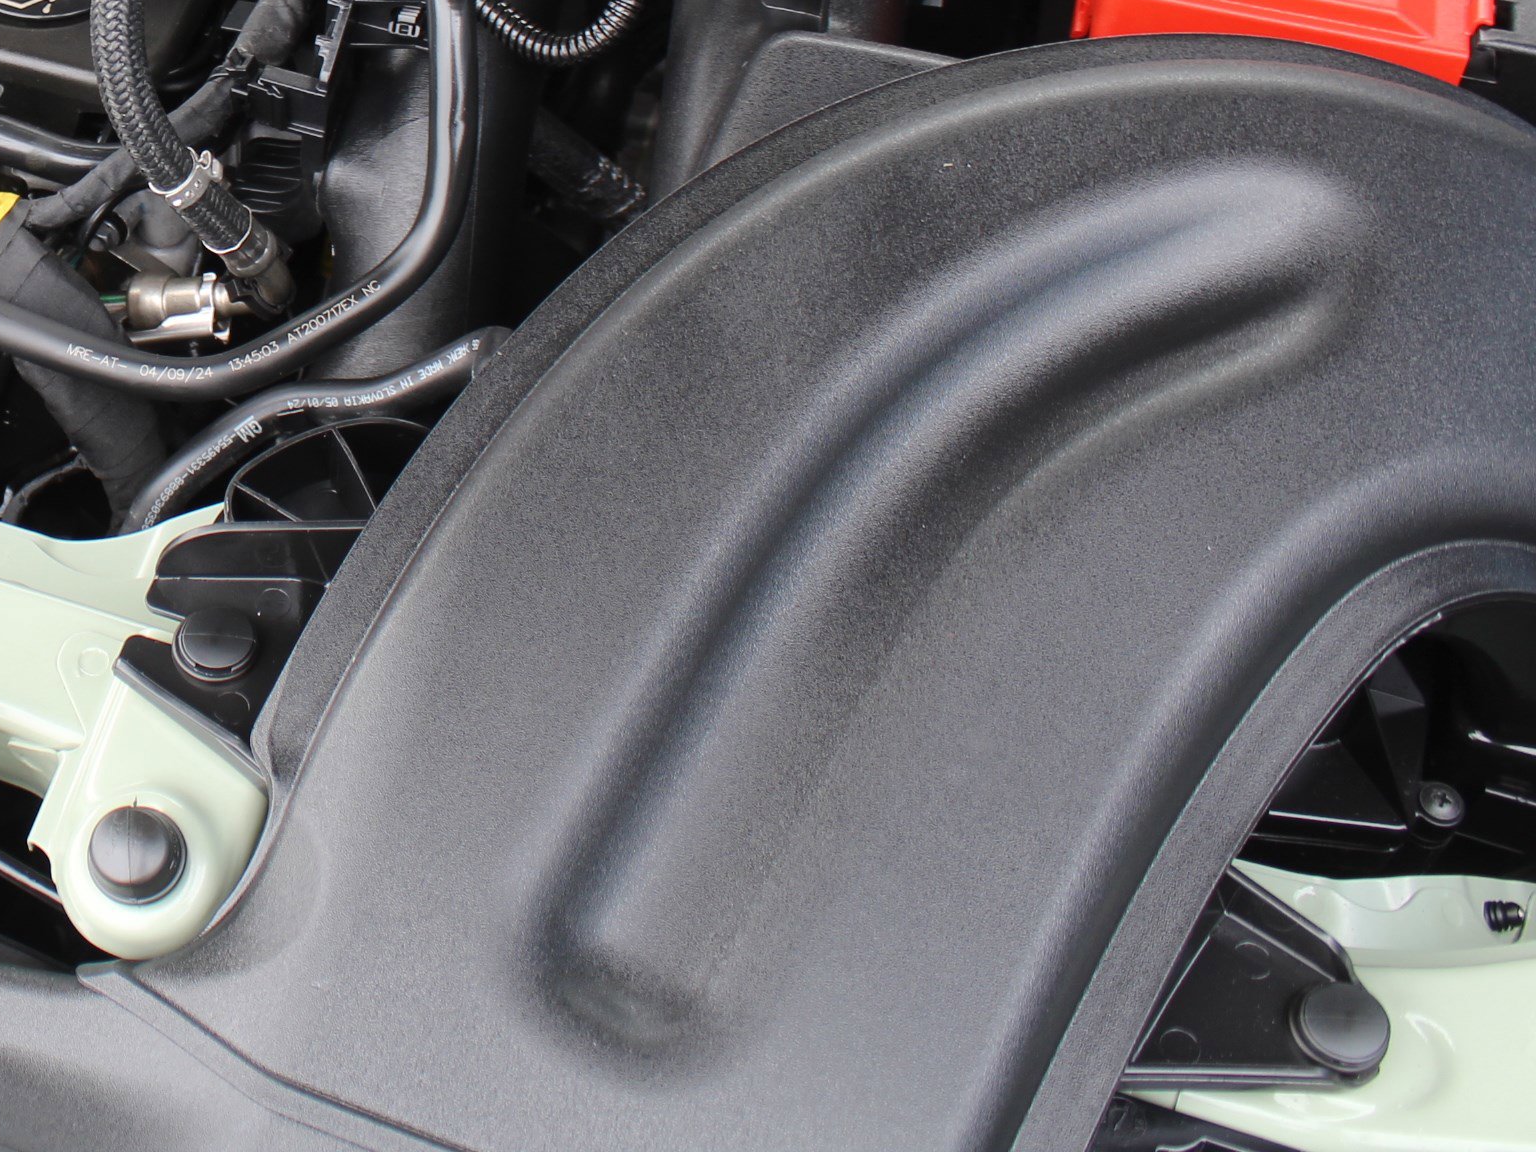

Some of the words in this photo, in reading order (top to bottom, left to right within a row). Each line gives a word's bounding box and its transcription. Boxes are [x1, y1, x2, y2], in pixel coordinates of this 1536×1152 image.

[139, 363, 214, 383] 04/09/24
[226, 339, 280, 373] 13:45:03
[286, 294, 359, 345] AT200717EX
[361, 279, 382, 298] NC
